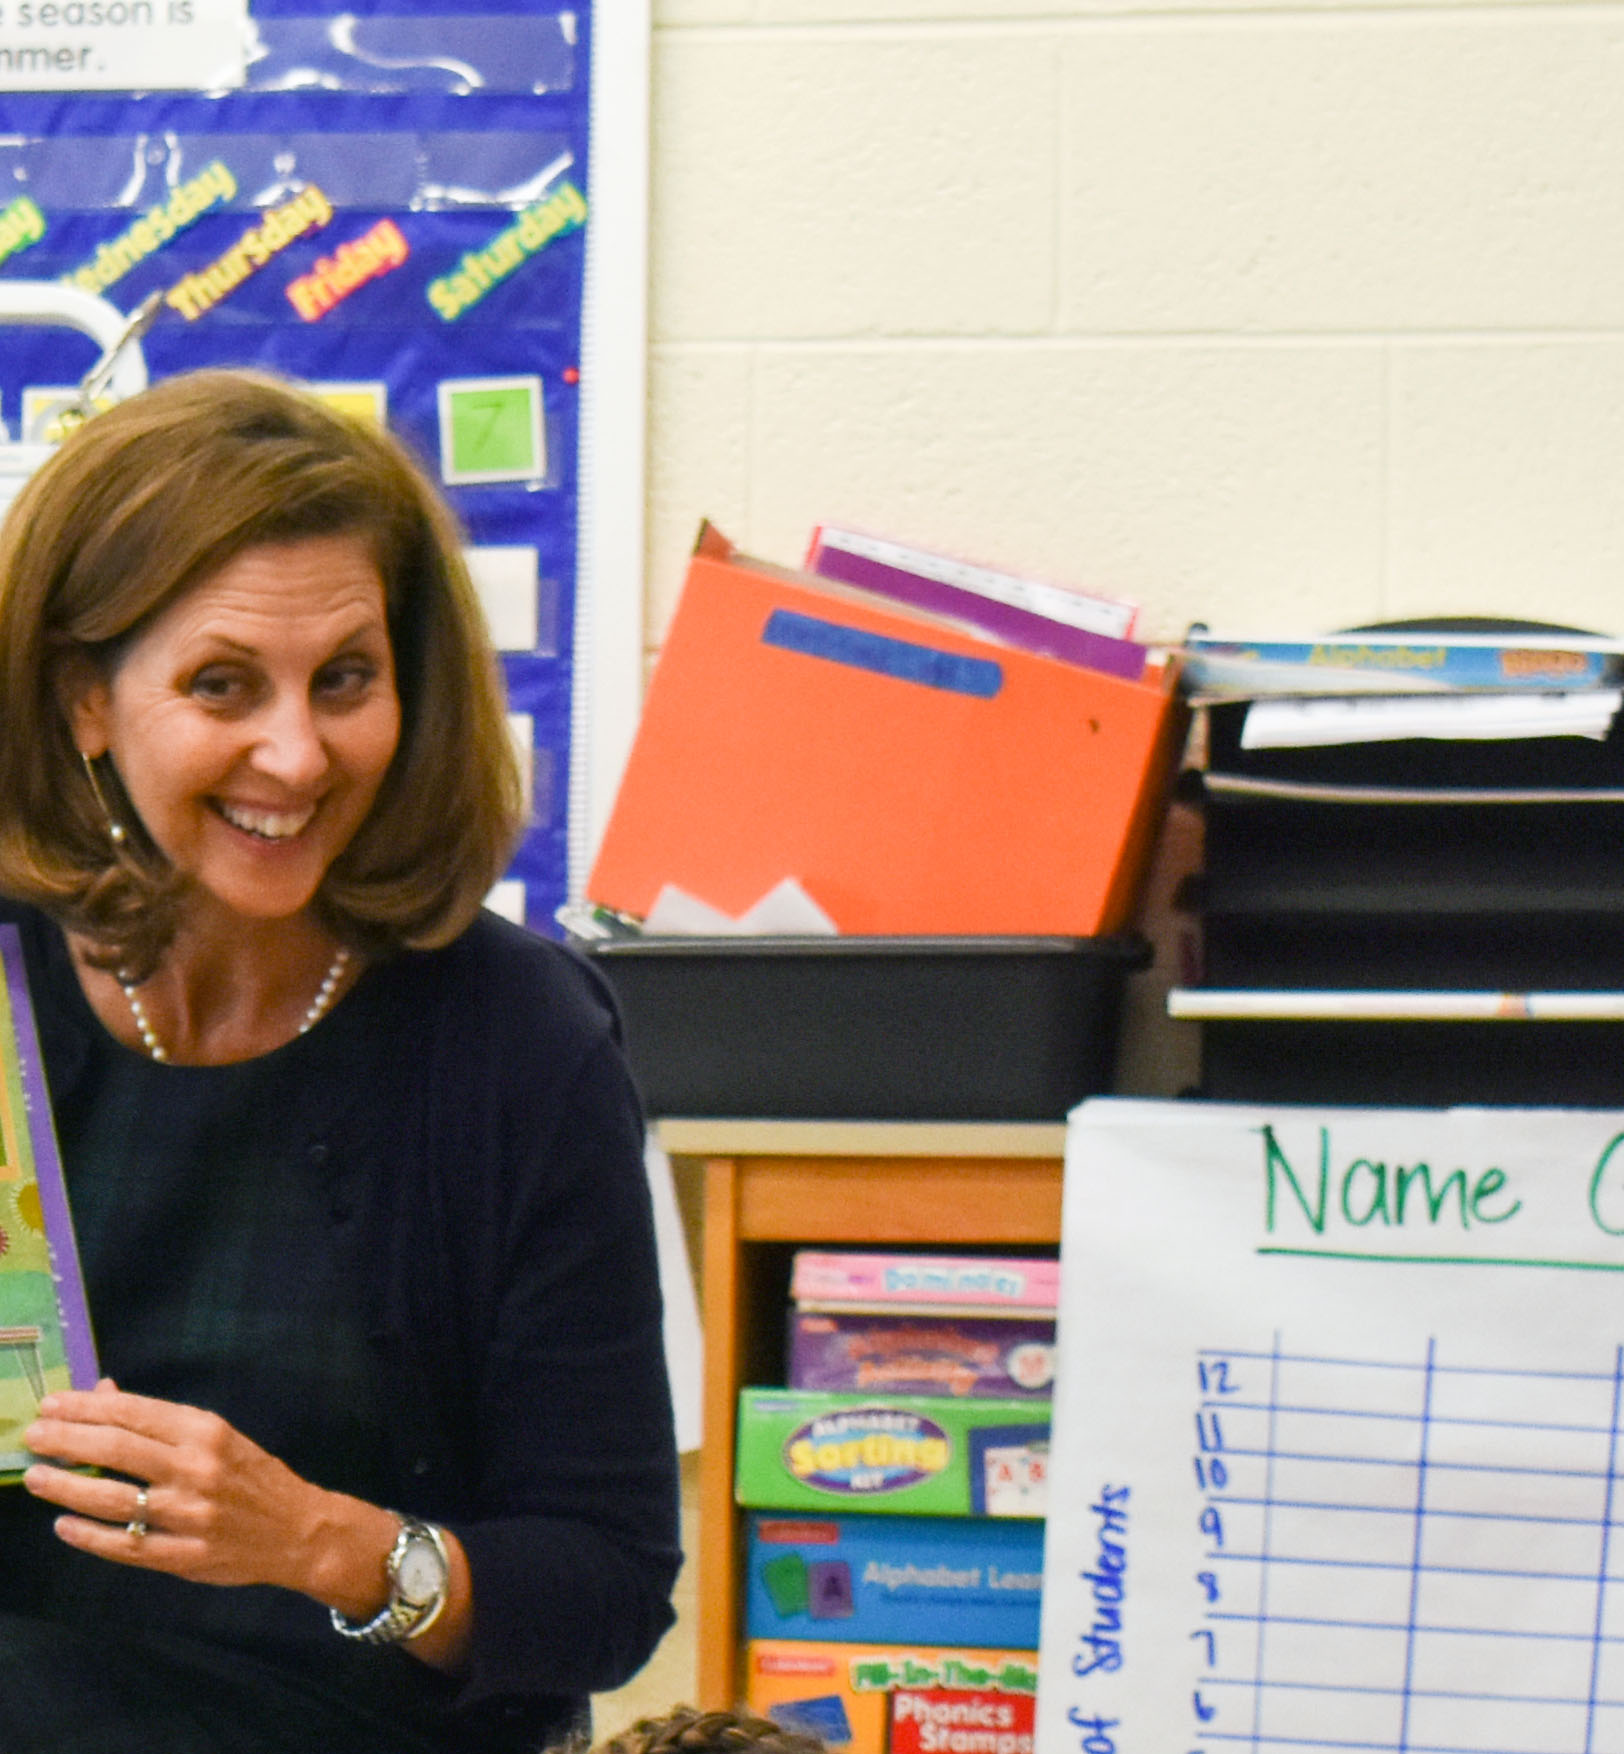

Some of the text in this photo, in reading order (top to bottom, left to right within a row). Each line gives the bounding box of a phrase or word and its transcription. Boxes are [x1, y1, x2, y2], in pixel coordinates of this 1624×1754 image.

[16, 1, 154, 27] season
[167, 0, 194, 25] is
[57, 160, 239, 296] ednesday
[165, 182, 334, 322] Thursday
[285, 217, 411, 323] Friday
[426, 181, 590, 322] Saturday
[470, 399, 505, 456] 7
[1259, 1122, 1523, 1234] Name
[1197, 1360, 1240, 1394] 12
[788, 1434, 952, 1478] Sorting
[1193, 1456, 1229, 1490] 10
[1199, 1506, 1225, 1549] 9
[863, 1560, 982, 1591] Alphabet
[1071, 1481, 1133, 1678] Students
[1189, 1629, 1217, 1668] 7
[893, 1693, 1014, 1729] Phonics
